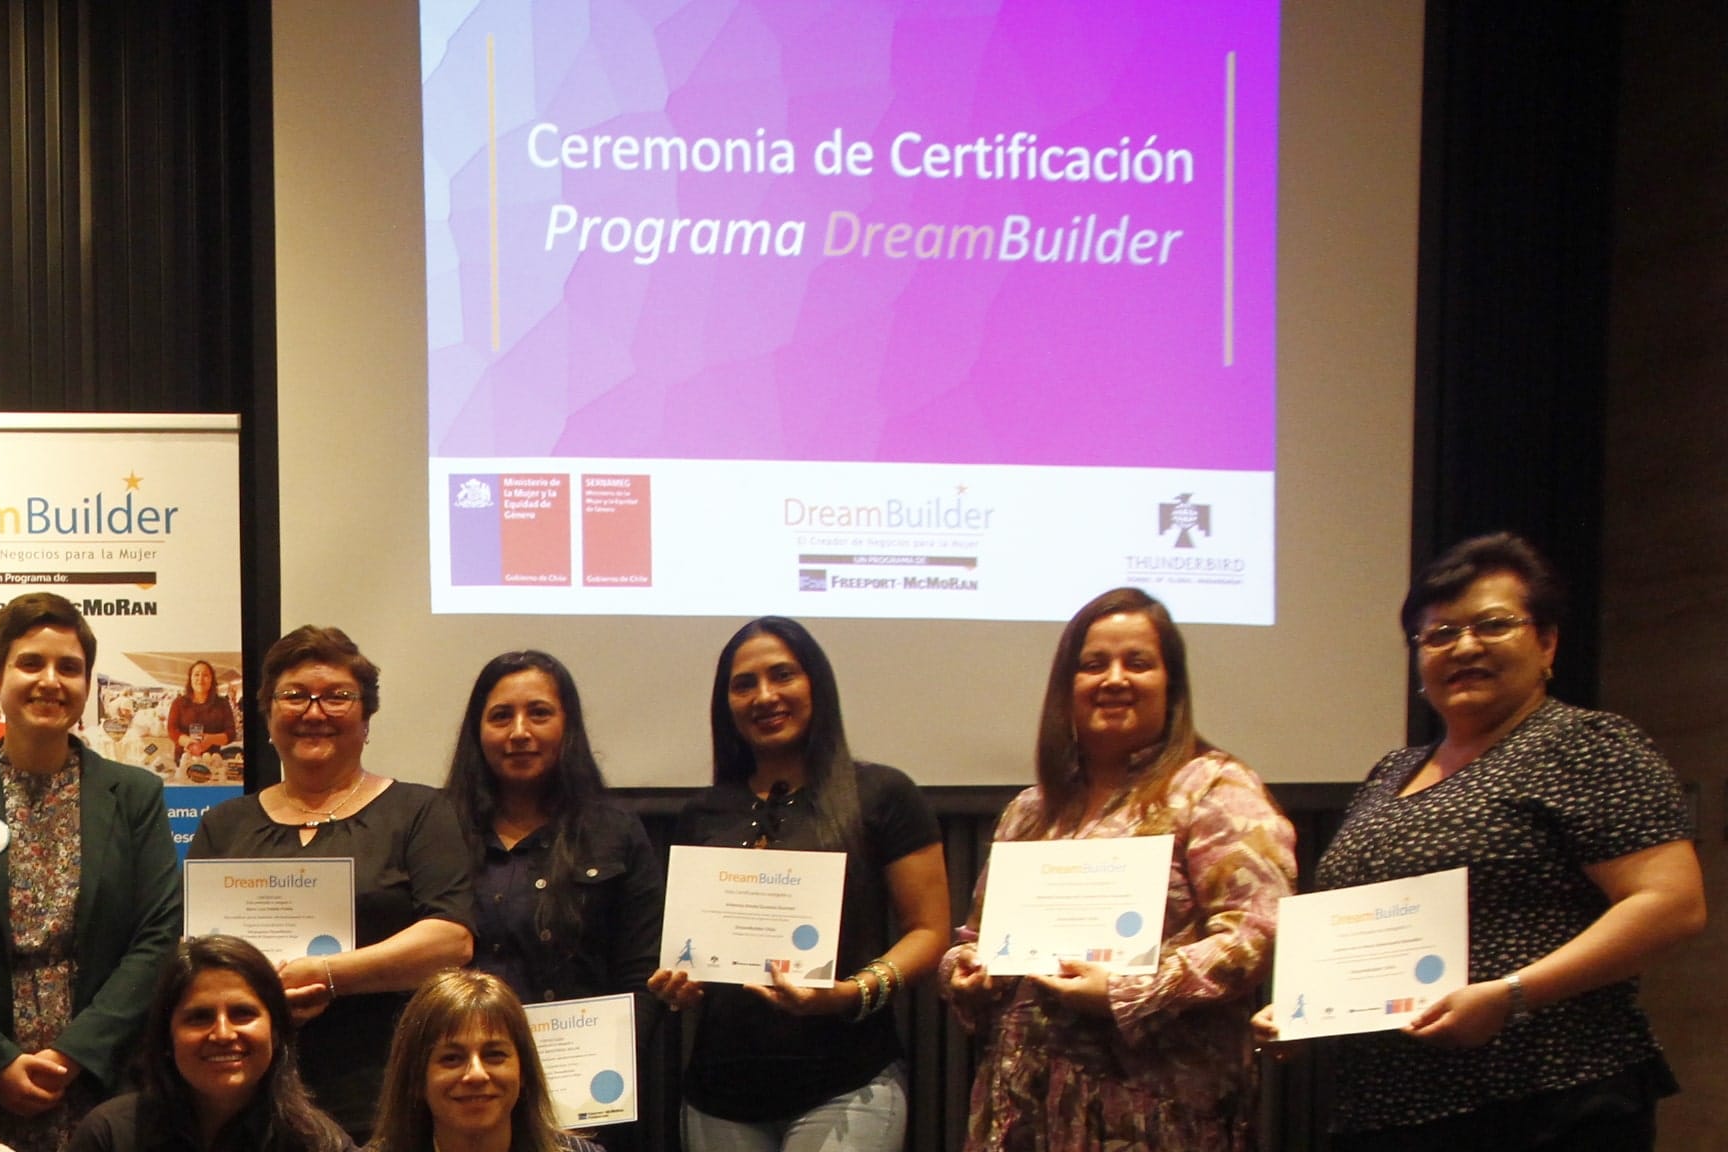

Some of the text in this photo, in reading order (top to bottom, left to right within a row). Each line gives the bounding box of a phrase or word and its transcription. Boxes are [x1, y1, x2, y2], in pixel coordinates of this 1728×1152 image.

[527, 123, 1194, 183] Ceremonia de Certificación
[544, 204, 1183, 265] Programa DreamBuilder
[784, 497, 995, 530] DreamBuilder
[0, 549, 60, 561] Negocios
[65, 551, 95, 561] para
[101, 550, 113, 560] la
[119, 550, 157, 561] Mujer
[5, 573, 52, 584] Programa
[53, 573, 69, 583] de:
[223, 874, 318, 889] DreamBuilder
[719, 870, 802, 886] DreamBuilder
[531, 1015, 599, 1032] amBuilder
